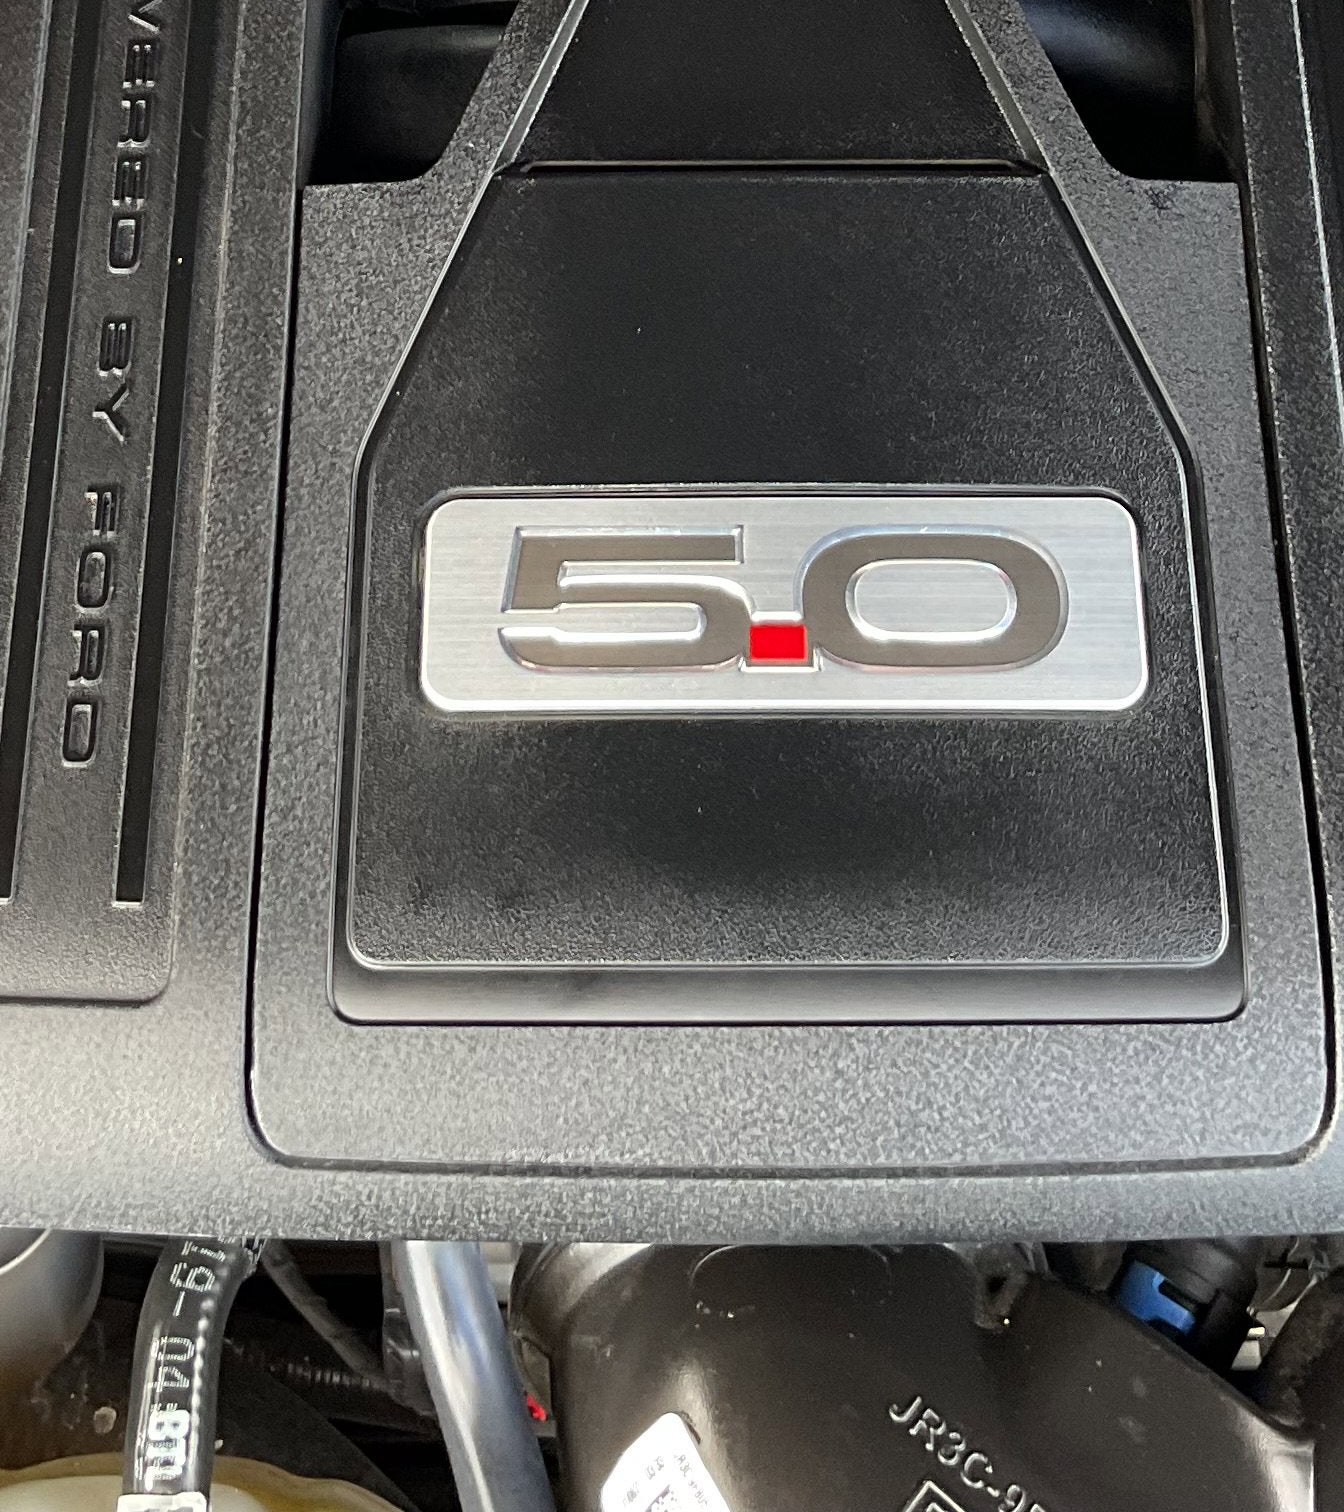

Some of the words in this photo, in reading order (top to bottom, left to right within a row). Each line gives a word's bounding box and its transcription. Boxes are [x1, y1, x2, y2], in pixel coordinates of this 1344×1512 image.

[92, 317, 137, 448] BY
[61, 483, 119, 770] FORD
[499, 524, 1071, 674] 5.0
